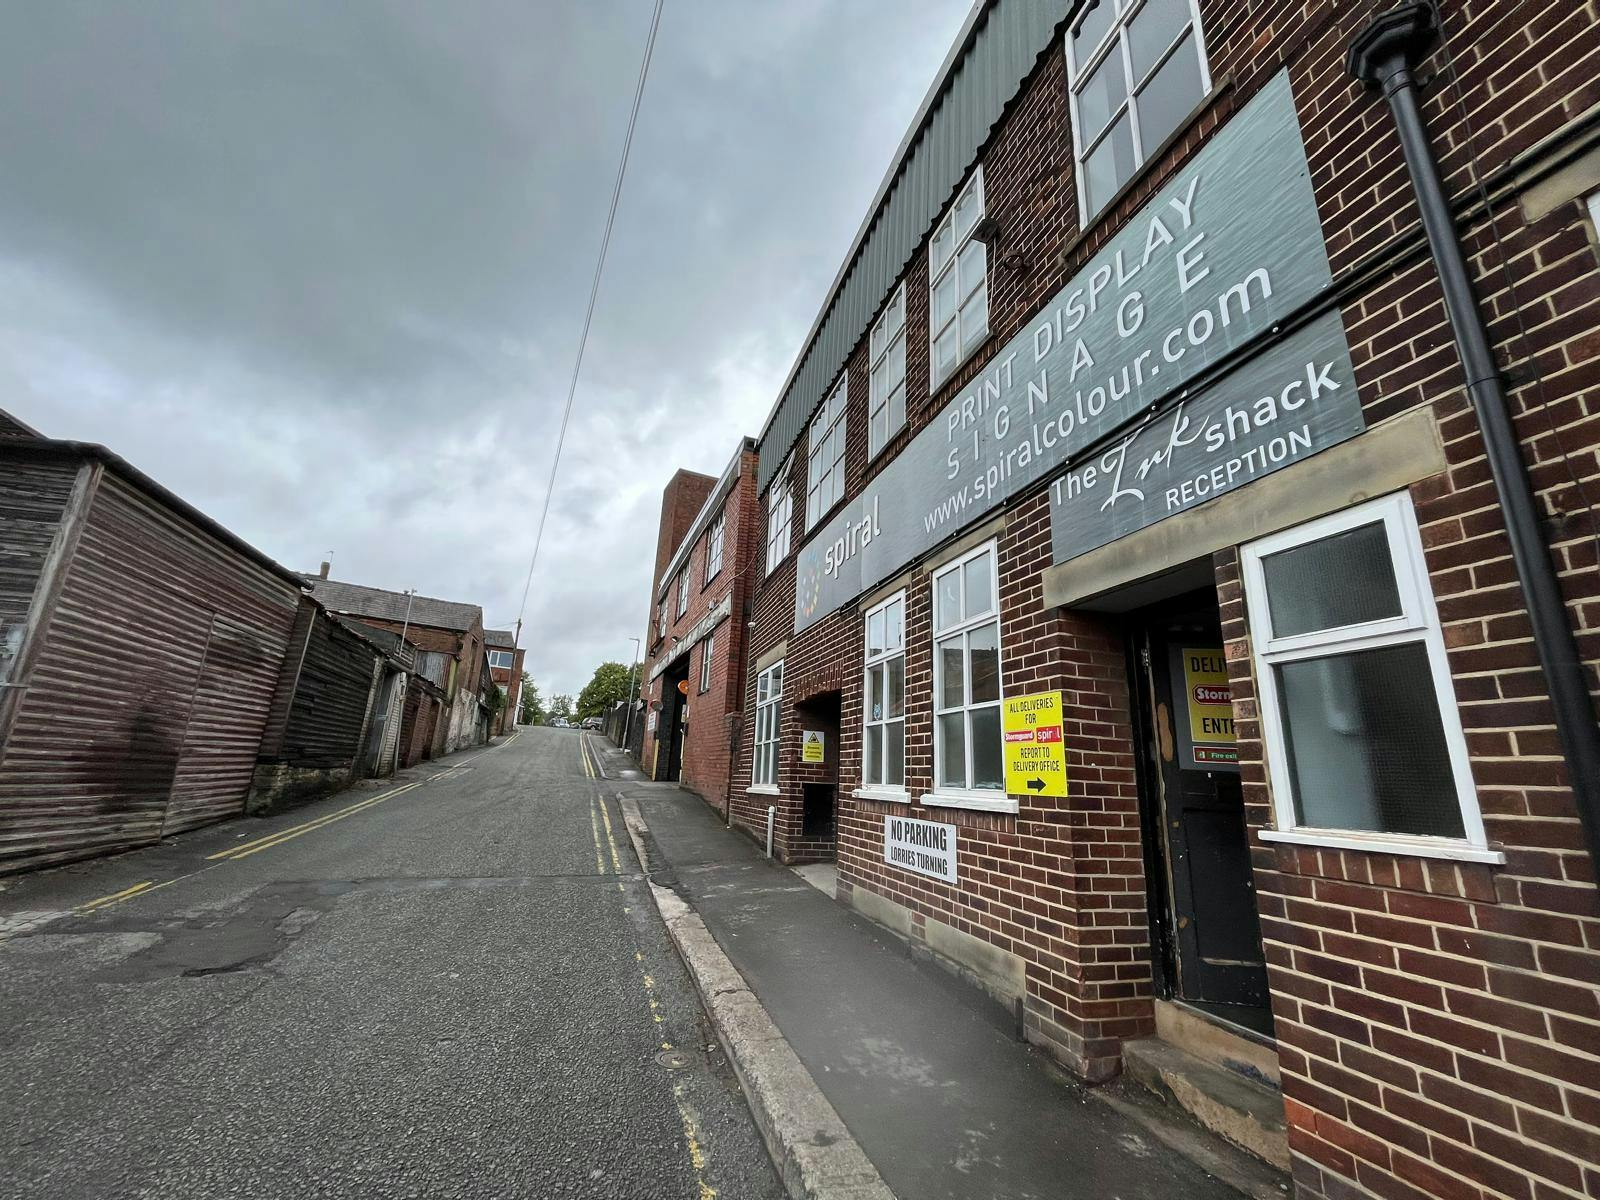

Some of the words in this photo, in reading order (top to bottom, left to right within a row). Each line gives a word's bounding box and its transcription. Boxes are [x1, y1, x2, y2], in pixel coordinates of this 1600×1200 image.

[947, 350, 1017, 442] PRINT
[1033, 175, 1199, 364] DISPLAY
[924, 267, 1273, 534] www.spiralcolour.com
[1051, 465, 1097, 505] The
[1206, 361, 1341, 452] shack
[1165, 425, 1312, 510] RECEPTION
[824, 494, 881, 579] spiral
[1009, 703, 1019, 713] ALL
[1020, 697, 1054, 712] DELIVERIES
[1025, 713, 1037, 724] FOR
[1013, 761, 1038, 771] DELIVERY
[1040, 760, 1060, 772] OFFICE
[1021, 747, 1041, 758] REPORT
[1042, 746, 1050, 758] TO
[891, 819, 902, 841] NO
[904, 821, 947, 851] PARKING
[891, 846, 915, 866] LORRIES
[917, 852, 947, 875] TURNING
